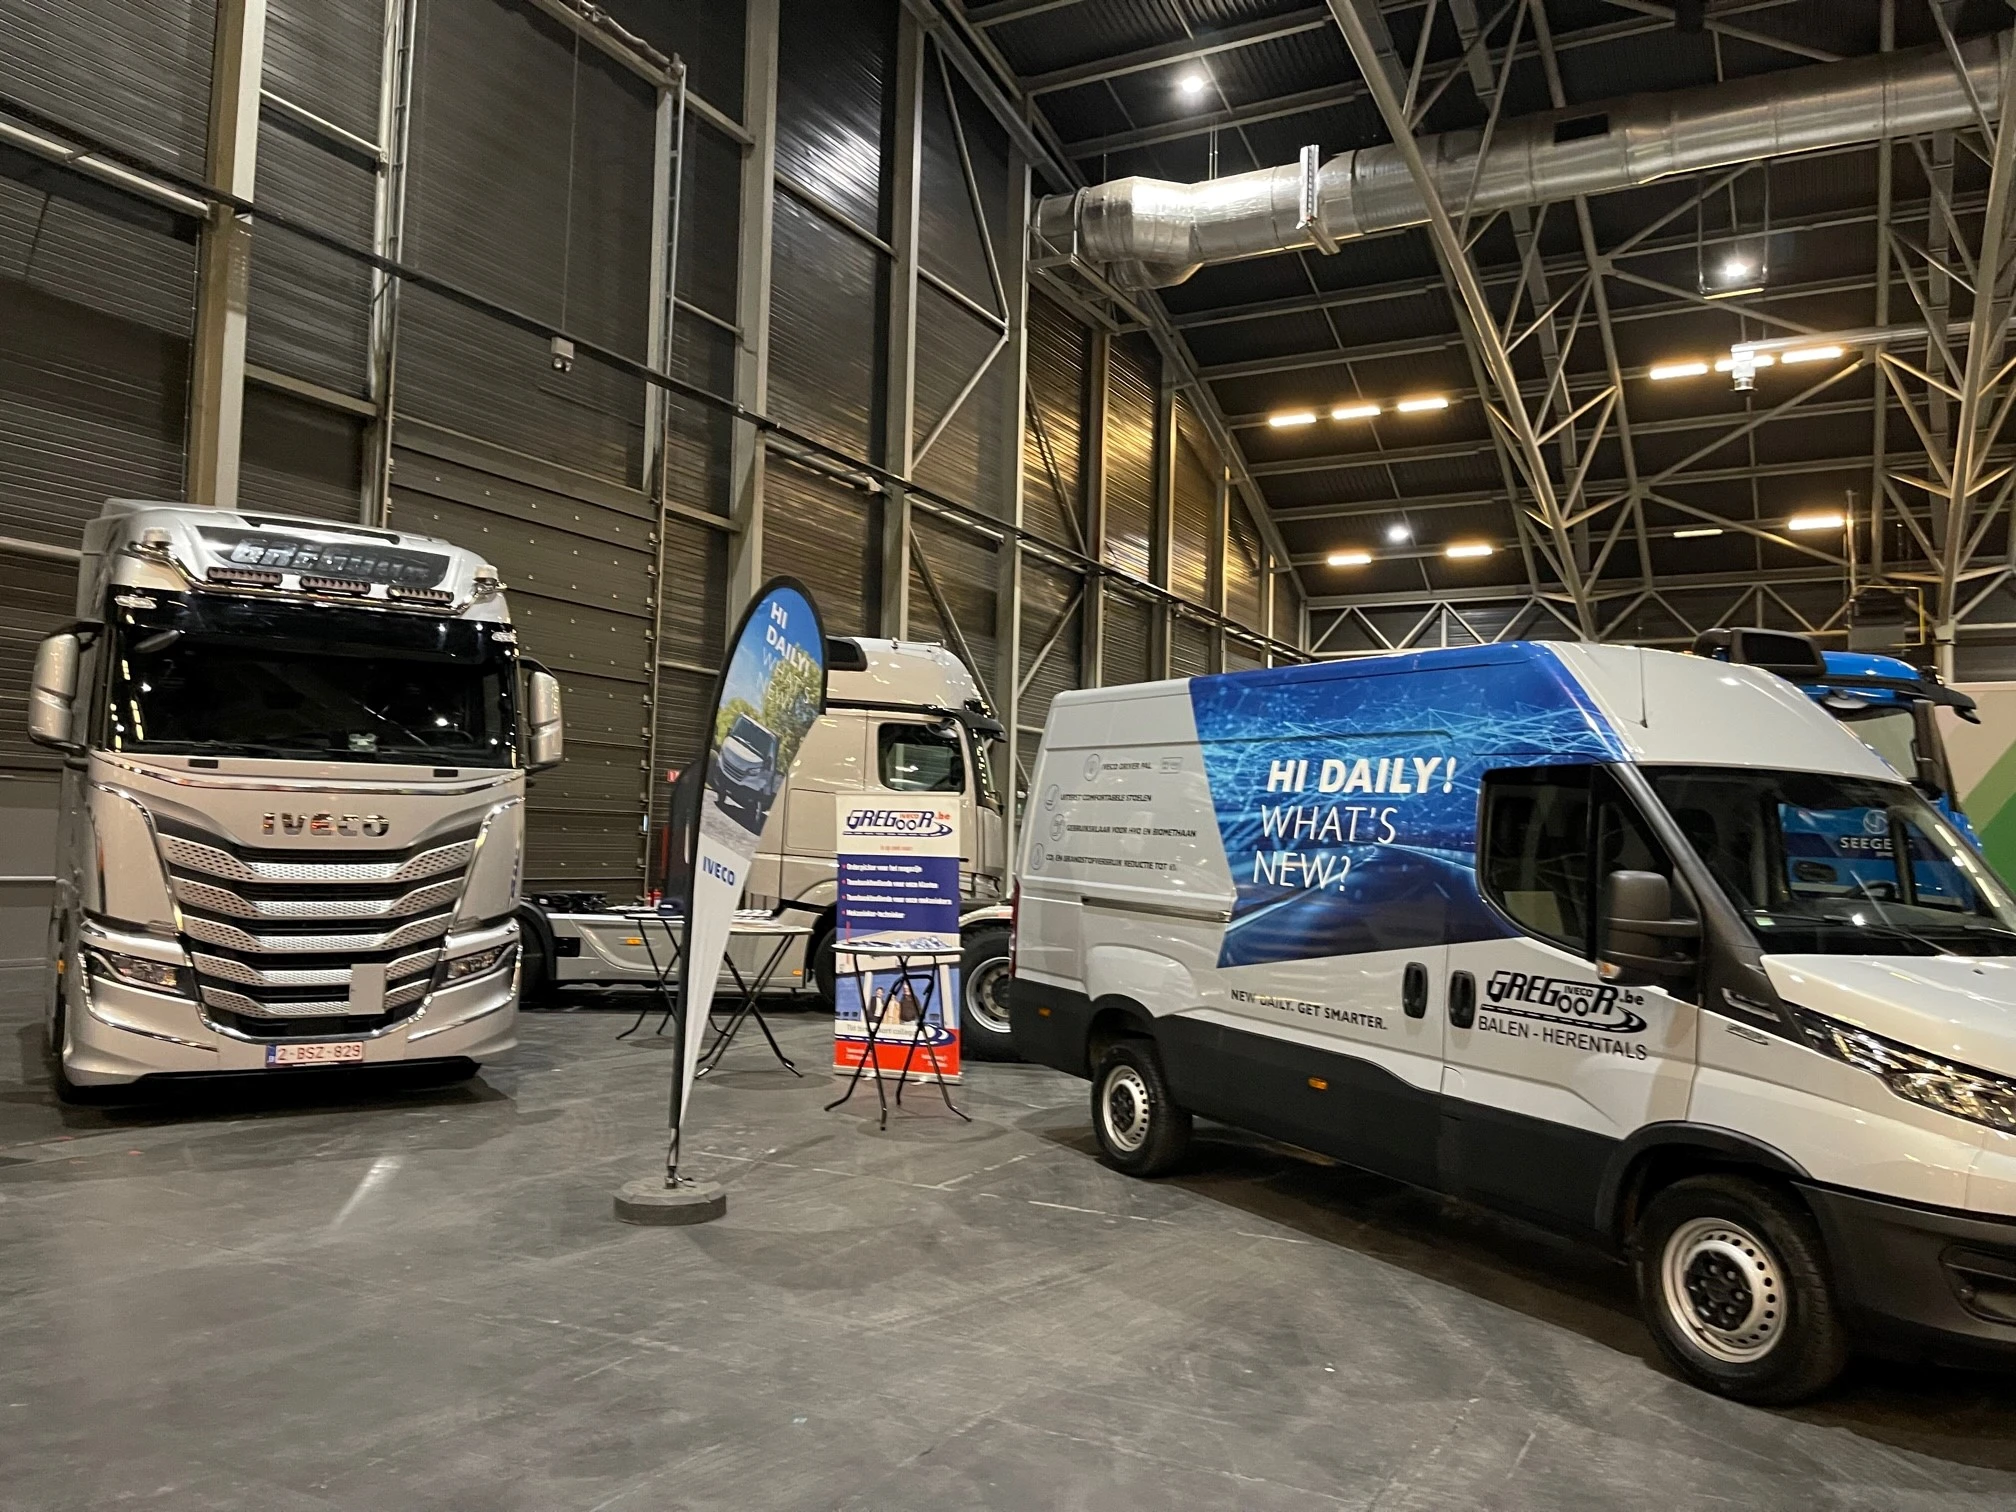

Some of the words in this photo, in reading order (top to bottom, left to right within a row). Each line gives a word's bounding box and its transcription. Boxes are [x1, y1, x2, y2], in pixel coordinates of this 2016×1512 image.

[770, 602, 788, 629] HI
[766, 625, 810, 677] DAILY!
[1266, 759, 1309, 793] HI
[1318, 756, 1457, 794] DAILY!
[263, 812, 390, 837] IVECO
[1261, 804, 1398, 844] WHAT'S
[1840, 837, 1914, 850] SEEGE
[703, 855, 736, 886] IVECO
[1253, 850, 1351, 892] NEW?
[1564, 985, 1593, 998] IVECO
[1231, 989, 1255, 1003] NEW
[1259, 995, 1294, 1012] DAILY.
[1298, 1002, 1320, 1017] GET
[1324, 1007, 1388, 1030] SMARTER.
[278, 1045, 360, 1060] 2-BSZ-829
[1478, 1015, 1529, 1039] BALEN
[1542, 1027, 1648, 1061] HERENTALS
